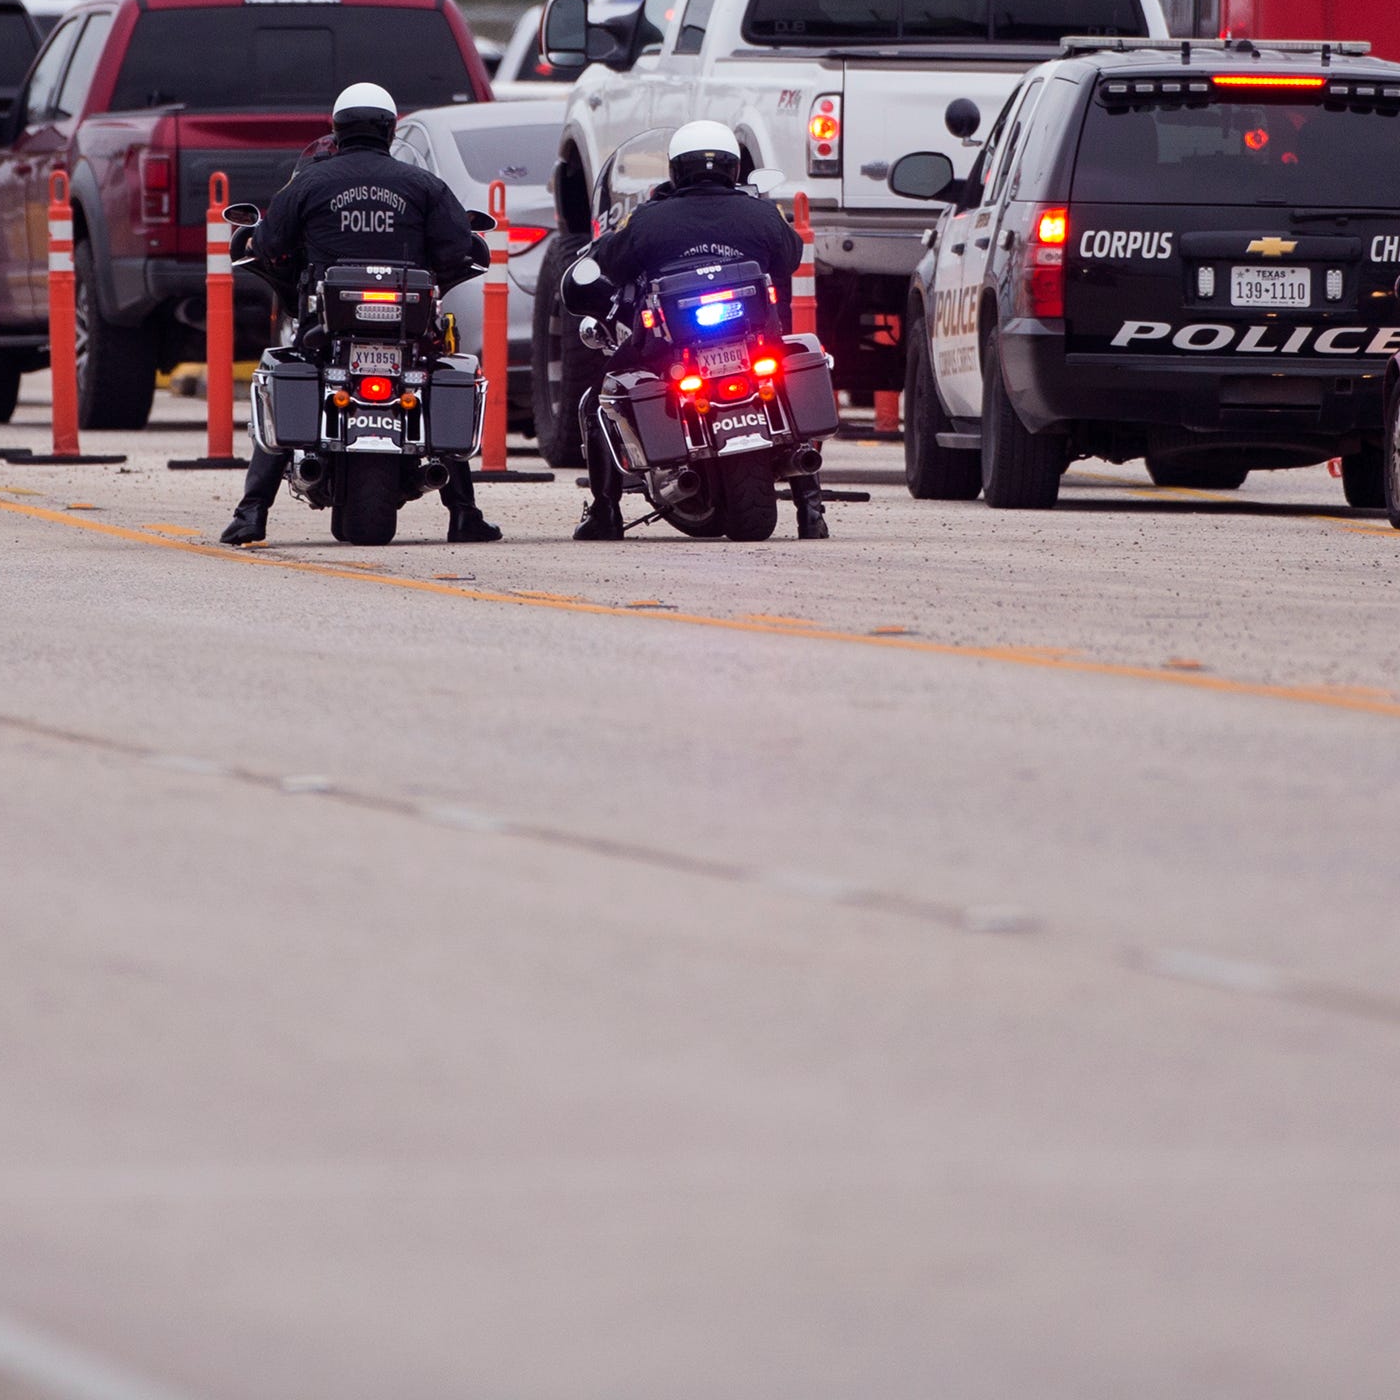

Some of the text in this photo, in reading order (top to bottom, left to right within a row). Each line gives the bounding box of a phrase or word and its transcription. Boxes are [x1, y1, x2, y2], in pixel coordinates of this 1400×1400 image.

[330, 186, 407, 214] CORPUS CHRISTI
[341, 211, 394, 232] POLICE
[1080, 230, 1173, 259] CORPUS
[1256, 270, 1286, 278] TEXAS
[935, 285, 978, 338] POLICE
[356, 351, 396, 364] XY1859
[347, 416, 402, 432] POLICE
[712, 414, 767, 434] POLICE
